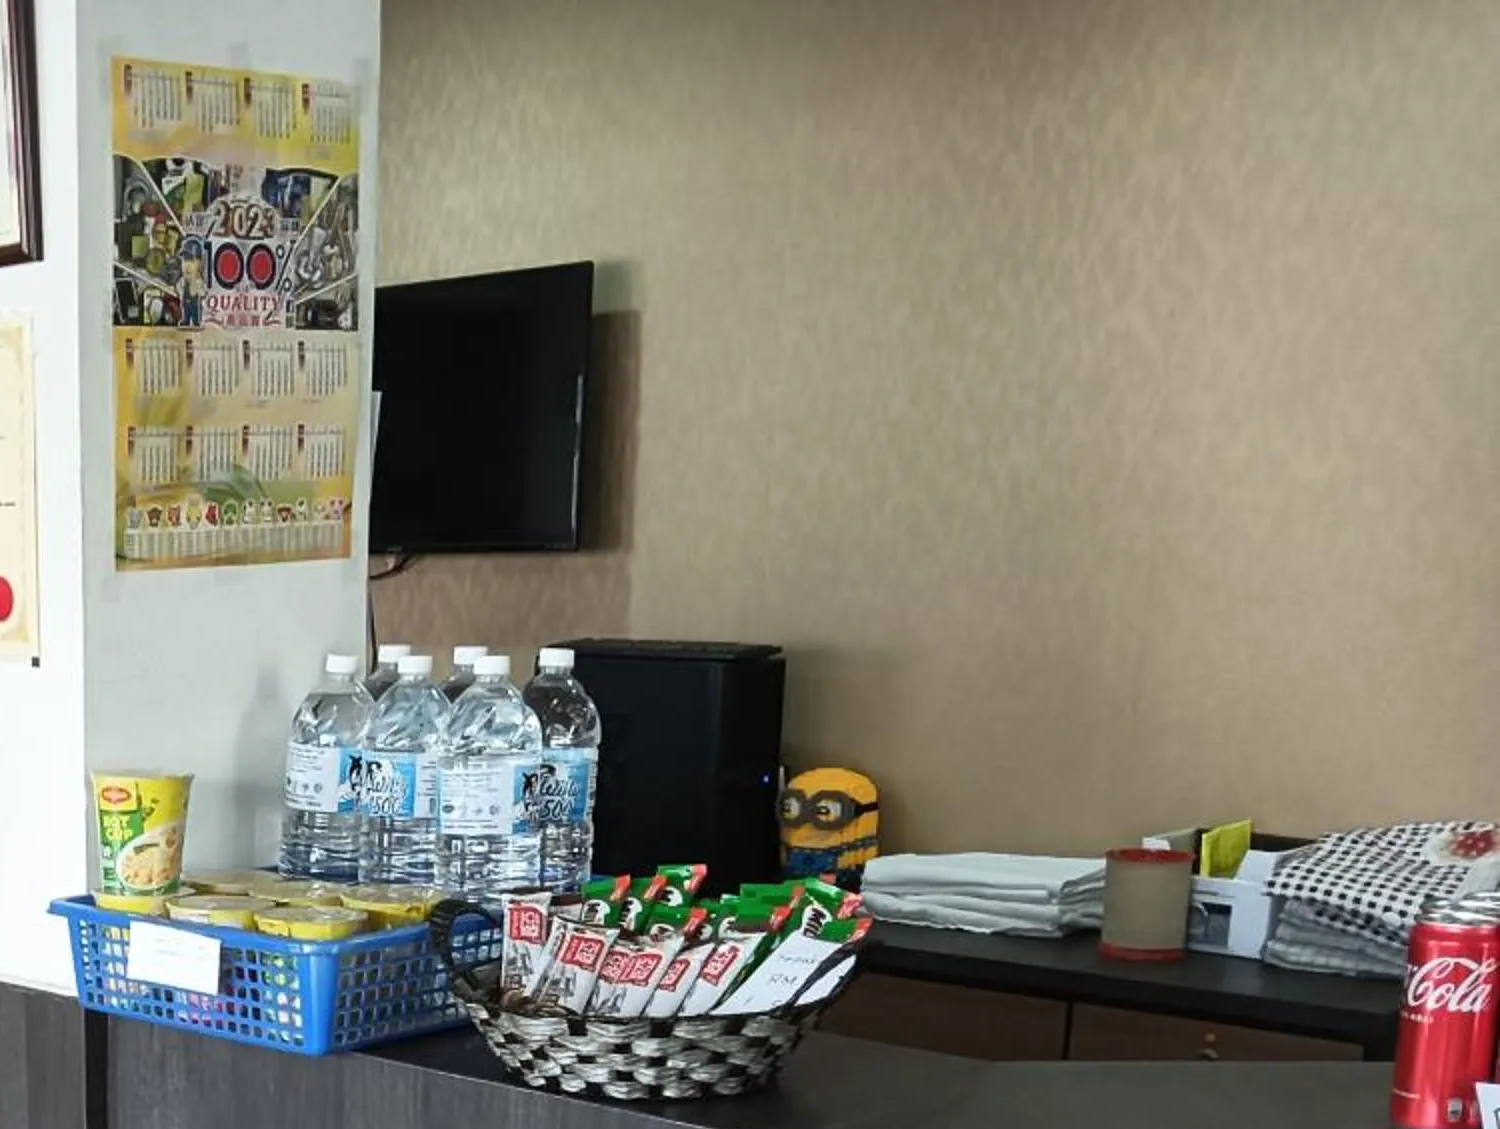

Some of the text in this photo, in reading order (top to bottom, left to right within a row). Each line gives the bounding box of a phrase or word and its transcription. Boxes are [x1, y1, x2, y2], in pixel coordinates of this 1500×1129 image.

[203, 239, 297, 292] 100%
[207, 295, 279, 313] QUALITY
[105, 827, 133, 841] CUP
[1407, 957, 1498, 1013] Cola
